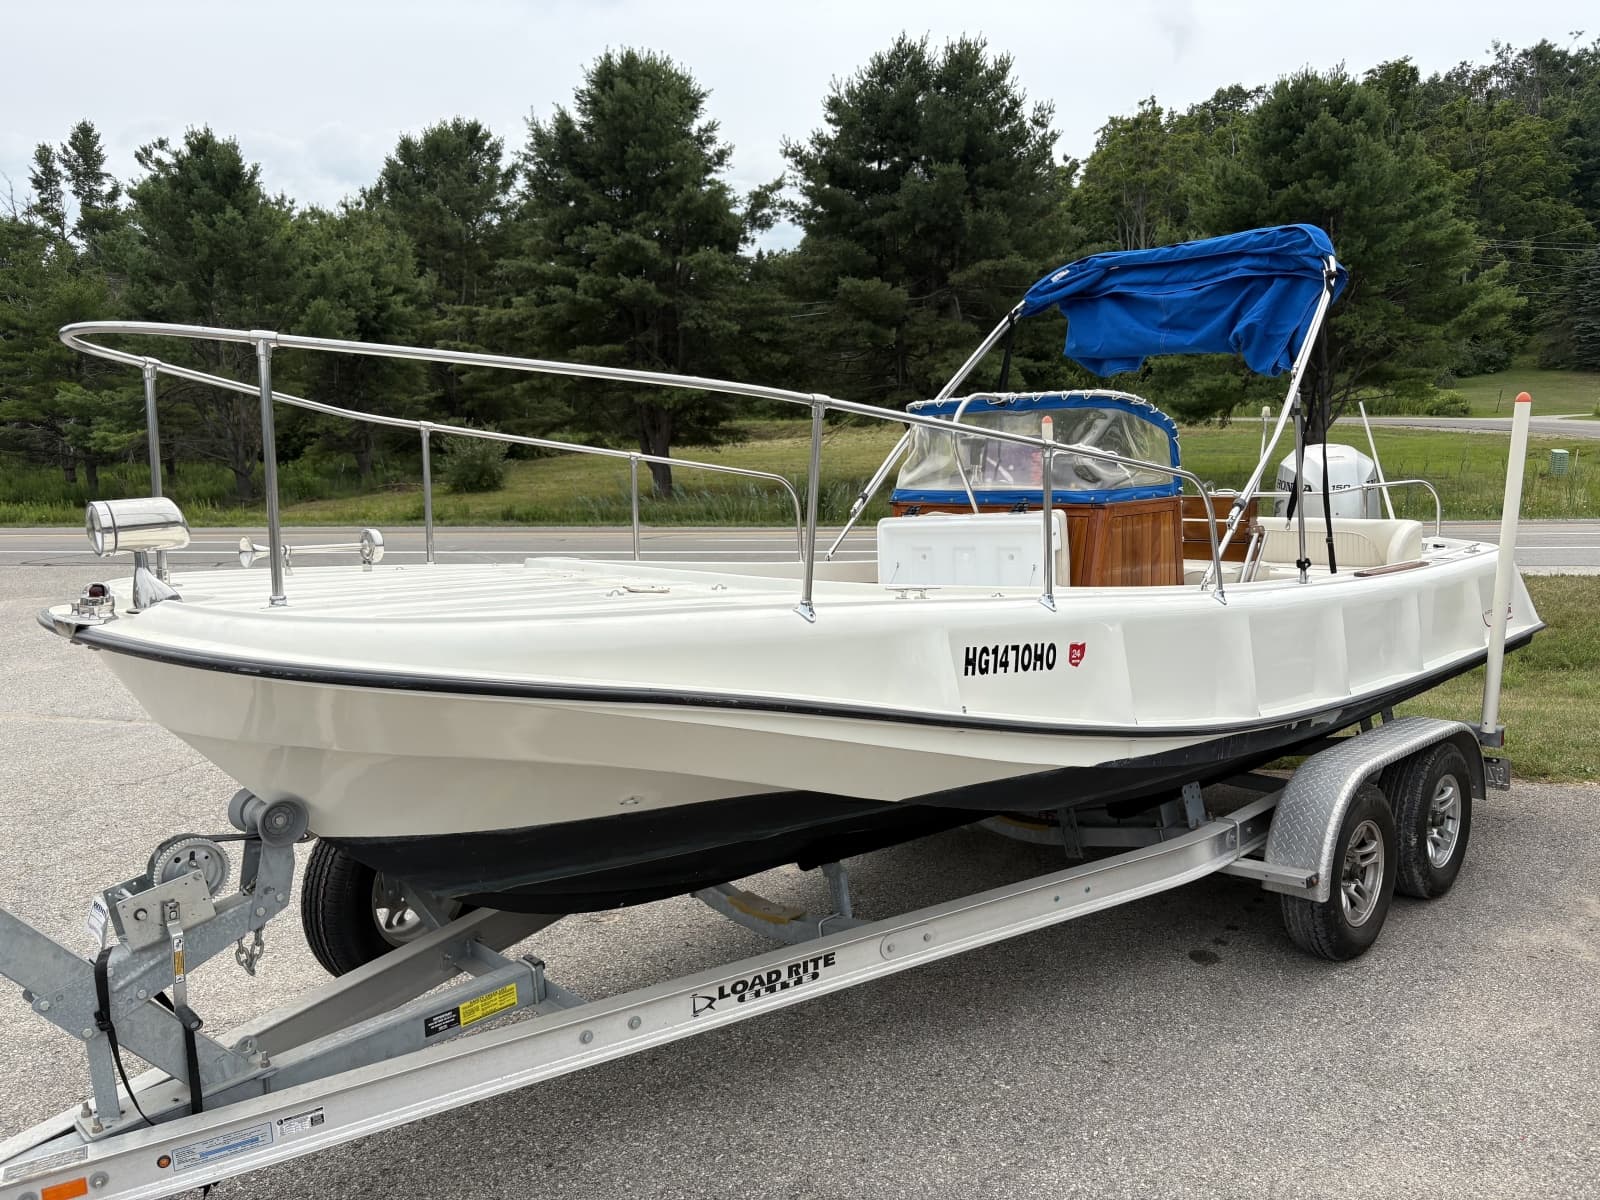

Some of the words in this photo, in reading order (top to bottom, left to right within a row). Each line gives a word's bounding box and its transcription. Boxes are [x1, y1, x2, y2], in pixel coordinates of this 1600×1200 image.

[1277, 479, 1312, 493] HONA
[718, 969, 782, 1000] LOAD
[787, 951, 836, 979] RITE
